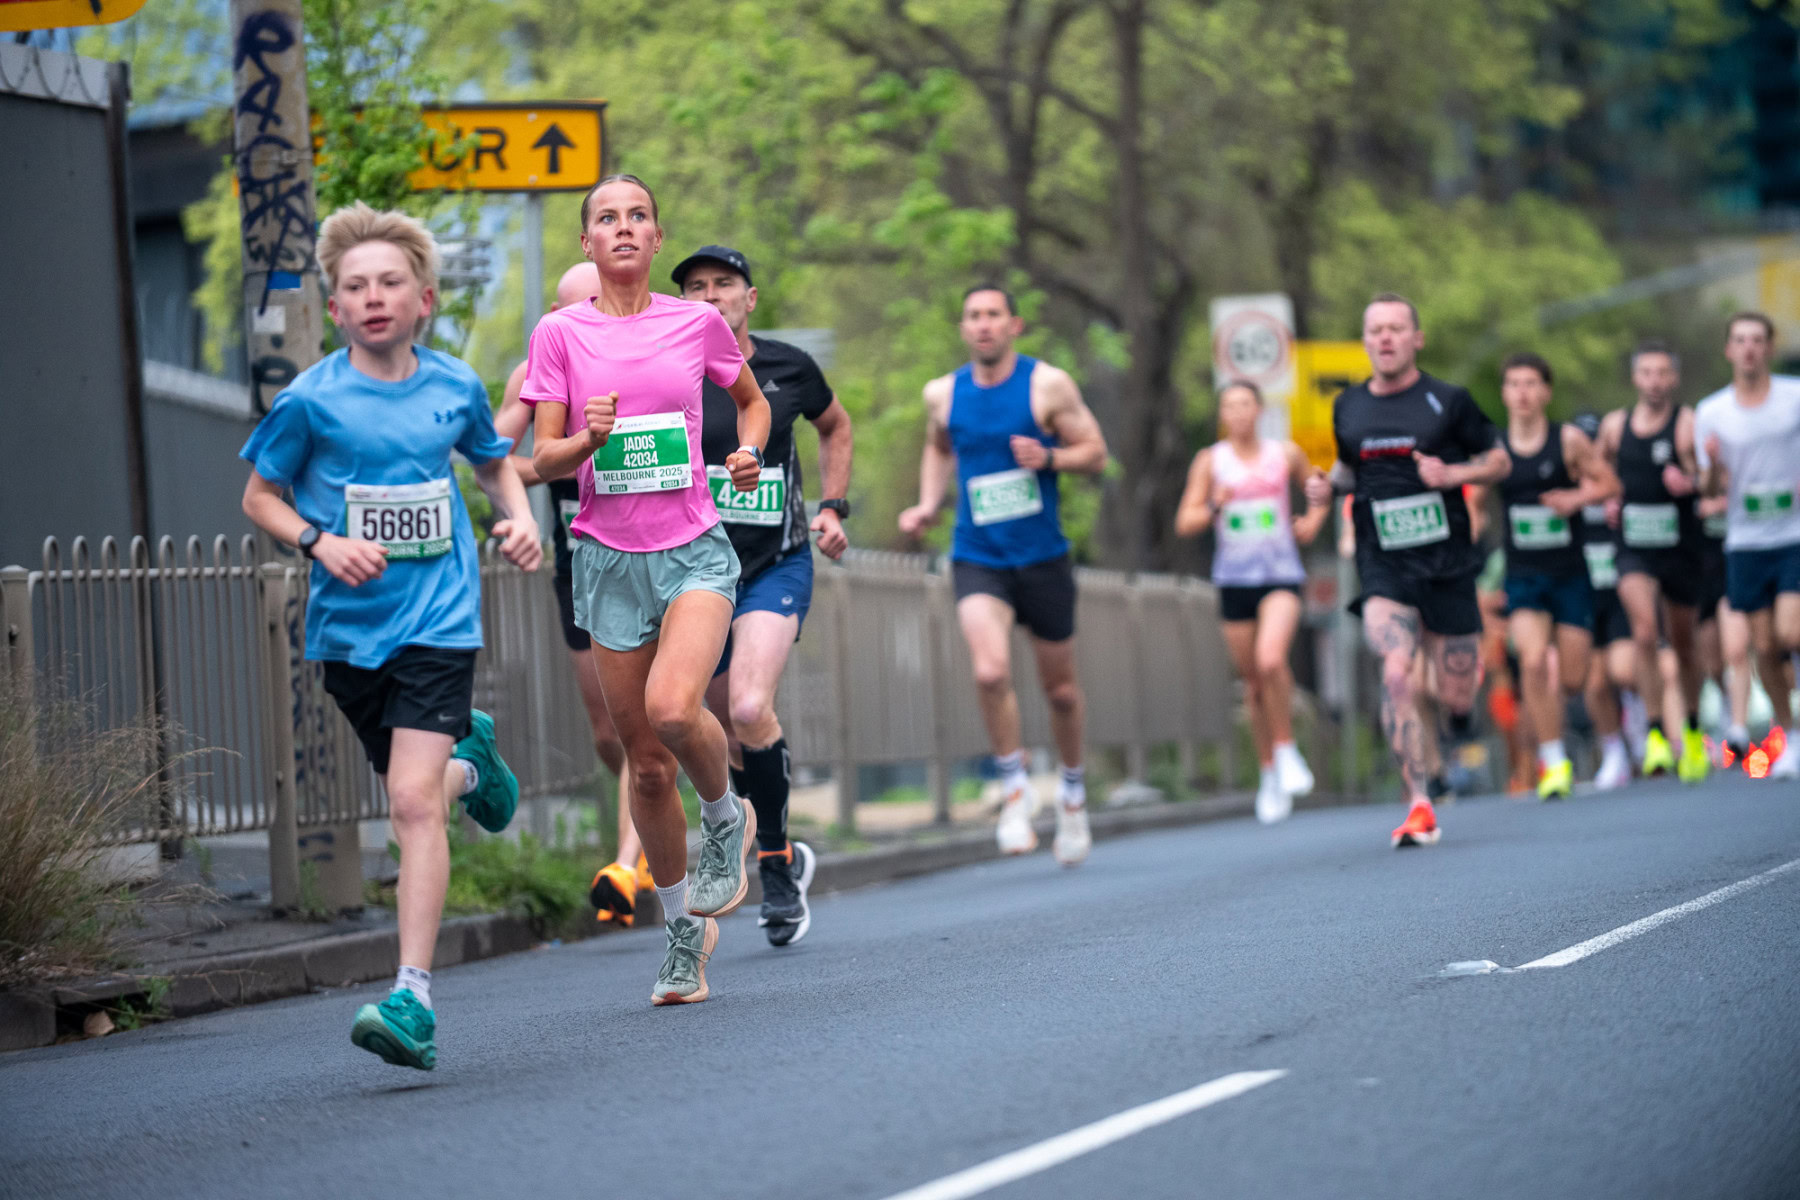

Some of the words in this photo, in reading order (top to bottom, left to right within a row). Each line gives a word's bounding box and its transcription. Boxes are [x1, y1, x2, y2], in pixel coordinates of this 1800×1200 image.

[428, 126, 508, 171] UR
[623, 434, 656, 452] JADOS
[623, 450, 659, 468] 42034
[602, 469, 657, 482] MELBOURNE
[659, 466, 683, 478] 2025
[362, 505, 440, 540] 56861
